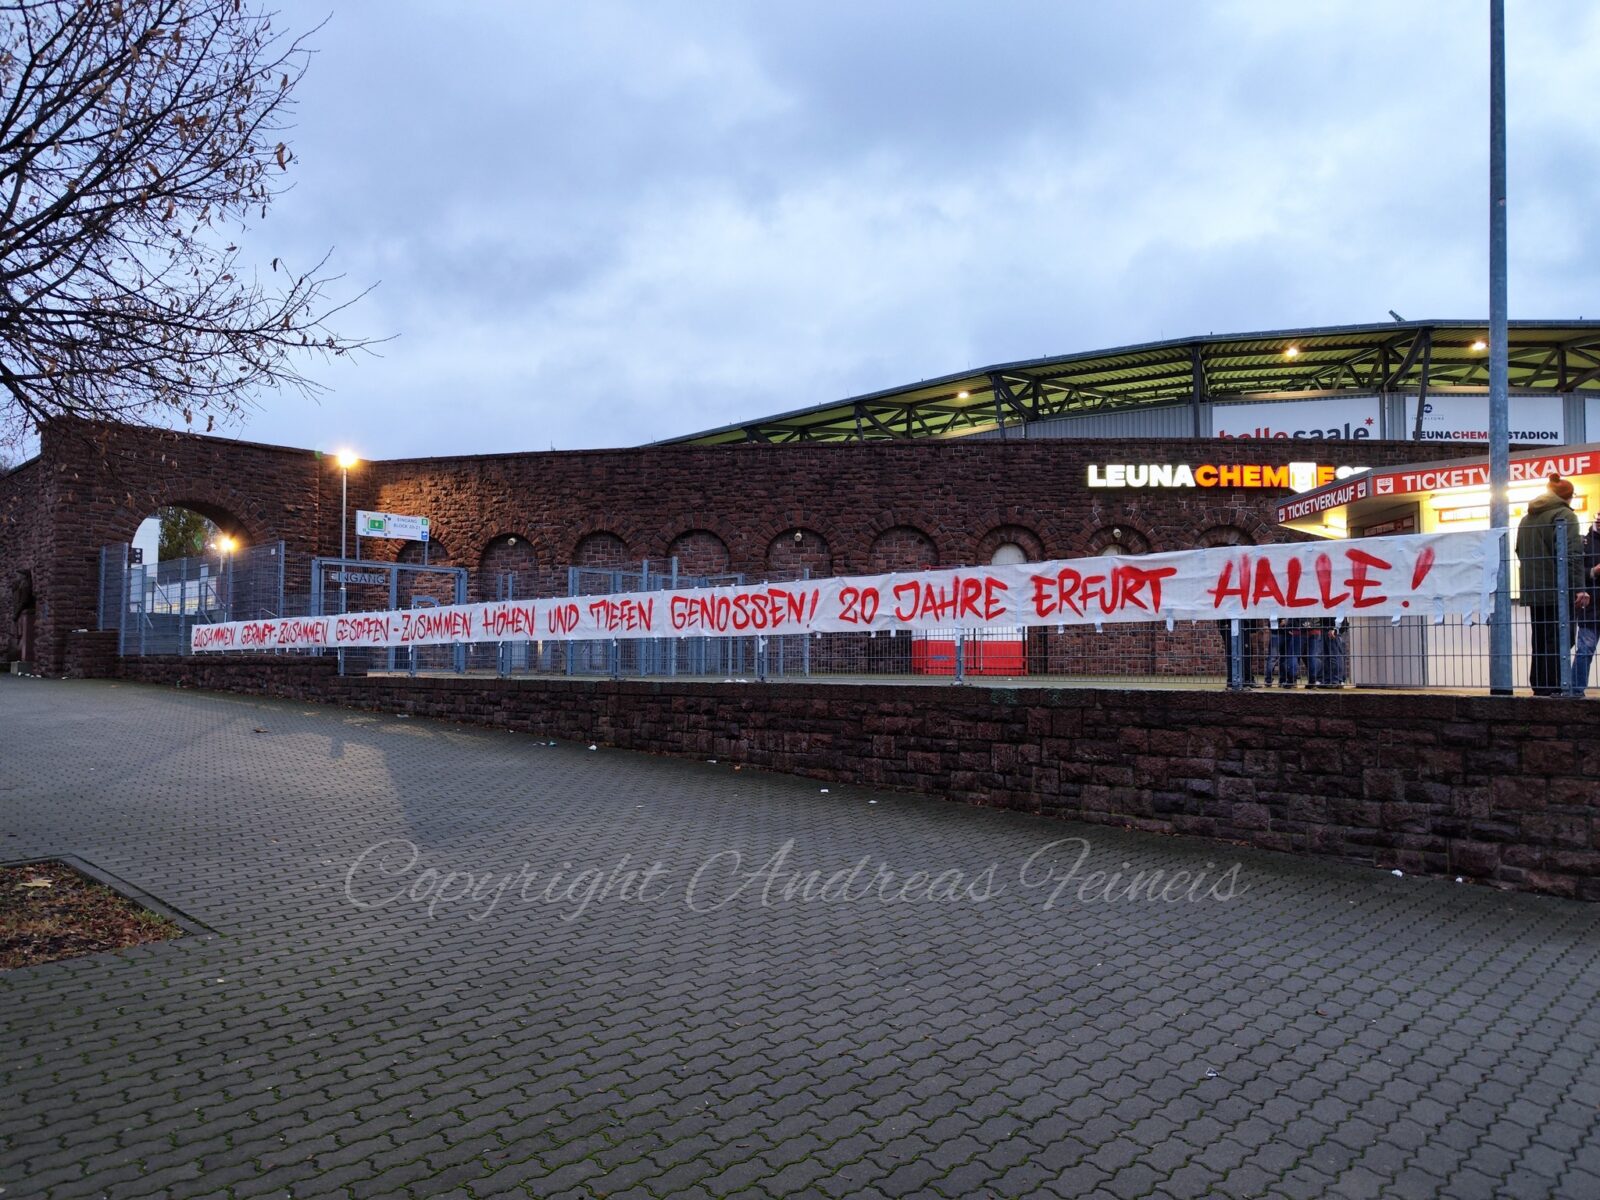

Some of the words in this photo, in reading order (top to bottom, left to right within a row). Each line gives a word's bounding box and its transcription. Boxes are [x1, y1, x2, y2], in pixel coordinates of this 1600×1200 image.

[1401, 455, 1591, 492] TICKETVRKAUF
[1287, 485, 1355, 519] TICKETVERKAUF
[331, 571, 385, 584] EINGANG
[193, 623, 235, 648] ZUSAMMEN
[482, 603, 535, 636] HÖHEN
[548, 604, 580, 634] UND
[590, 597, 653, 631] TIEFEN
[670, 588, 819, 630] GENOSSEN!
[838, 586, 880, 625] 20
[892, 575, 1009, 621] JAHRE
[1030, 565, 1178, 618] ERFURT
